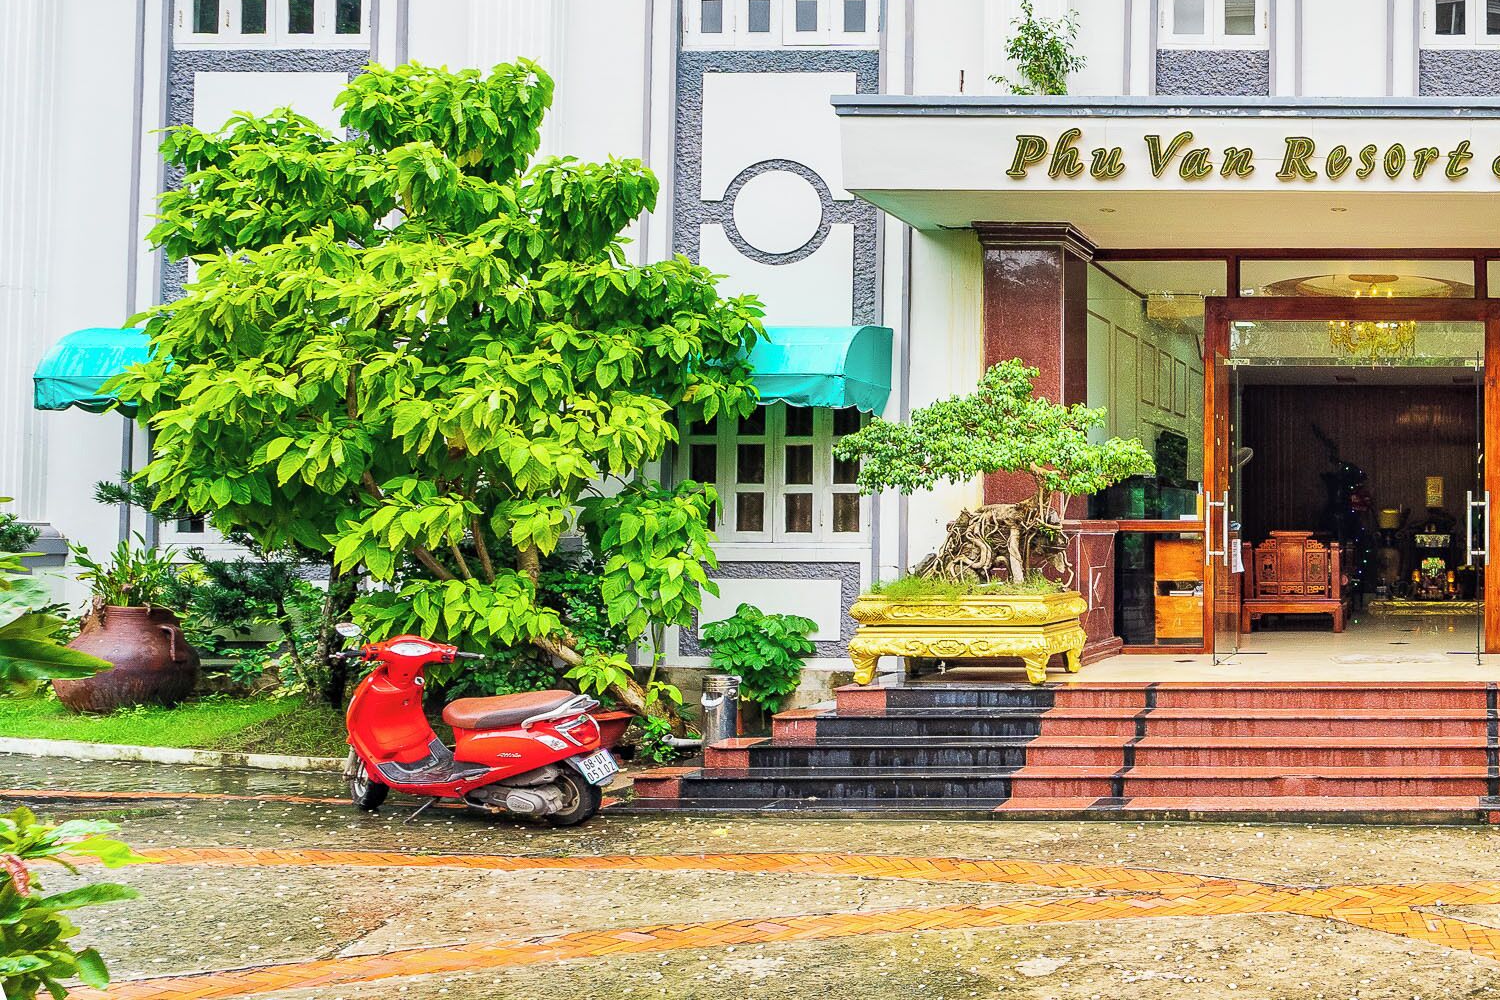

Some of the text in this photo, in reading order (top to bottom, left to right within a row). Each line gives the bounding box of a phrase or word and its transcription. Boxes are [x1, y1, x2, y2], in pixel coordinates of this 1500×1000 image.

[1006, 128, 1125, 179] Phu
[1144, 131, 1255, 180] Van
[1276, 136, 1473, 180] Resort
